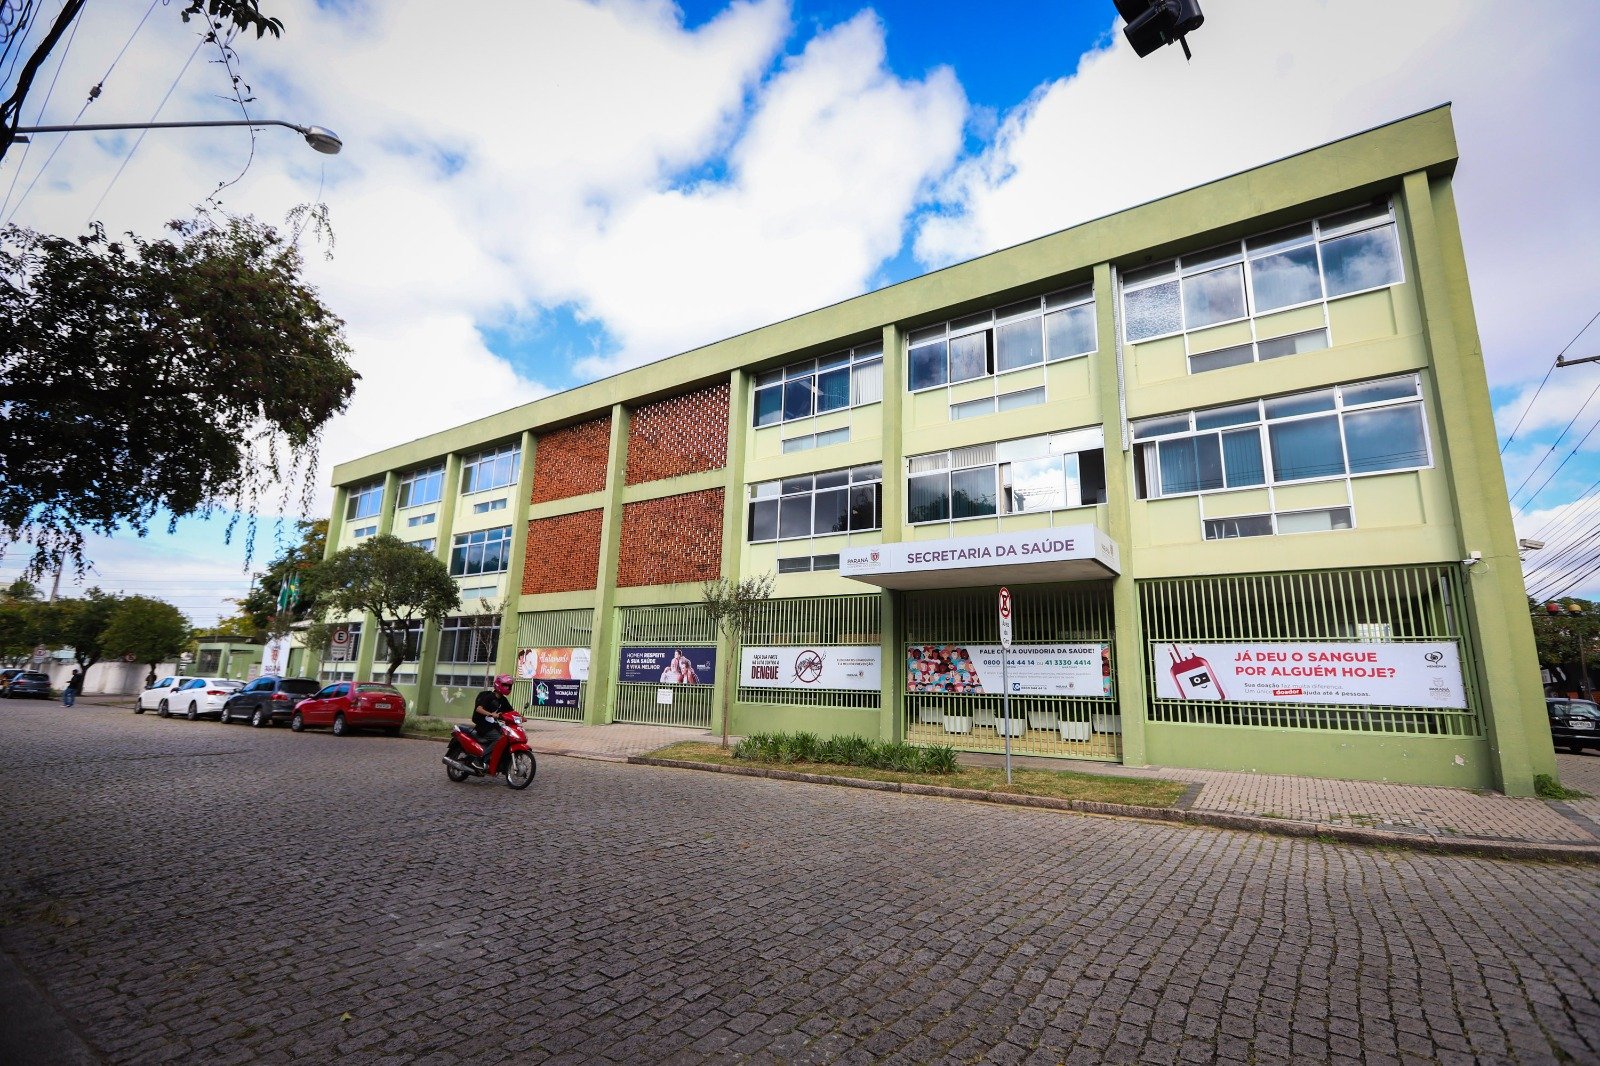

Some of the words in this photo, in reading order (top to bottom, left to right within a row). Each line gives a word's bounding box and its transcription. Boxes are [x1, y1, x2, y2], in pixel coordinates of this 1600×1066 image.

[907, 546, 991, 563] SECRETARIA
[995, 544, 1017, 557] DA
[1021, 538, 1075, 555] SAÚDE
[338, 632, 344, 641] E
[1234, 649, 1252, 662] JÁ
[1256, 652, 1287, 662] DEU
[1291, 652, 1303, 662] O
[1308, 652, 1378, 663] SANGUE
[751, 665, 779, 680] DENGUE
[1235, 666, 1267, 676] POR
[1271, 664, 1337, 677] ALGUÉM
[1342, 666, 1396, 678] HOJE?
